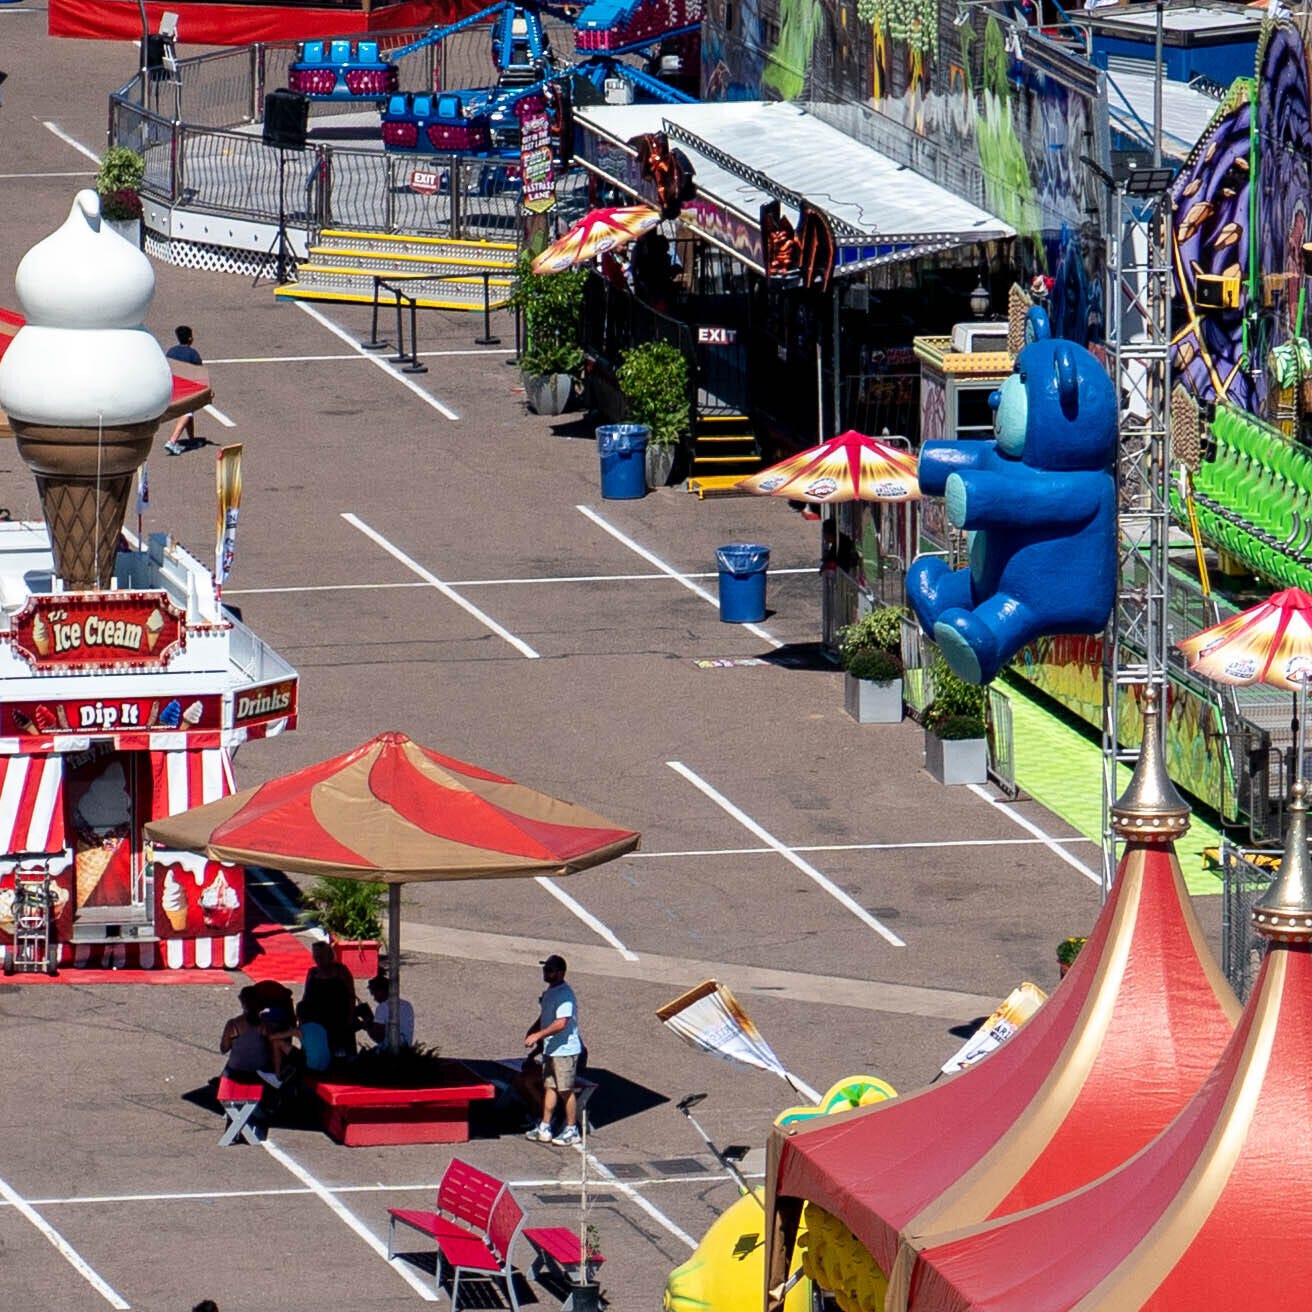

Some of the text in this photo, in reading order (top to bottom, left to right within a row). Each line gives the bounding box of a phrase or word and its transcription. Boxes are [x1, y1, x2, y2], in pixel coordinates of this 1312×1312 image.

[414, 172, 437, 185] EXIT
[528, 190, 551, 201] LANE
[698, 327, 737, 342] EXIT
[54, 615, 143, 653] Ice Cream
[237, 688, 291, 719] Drinks
[79, 702, 139, 728] Dip It
